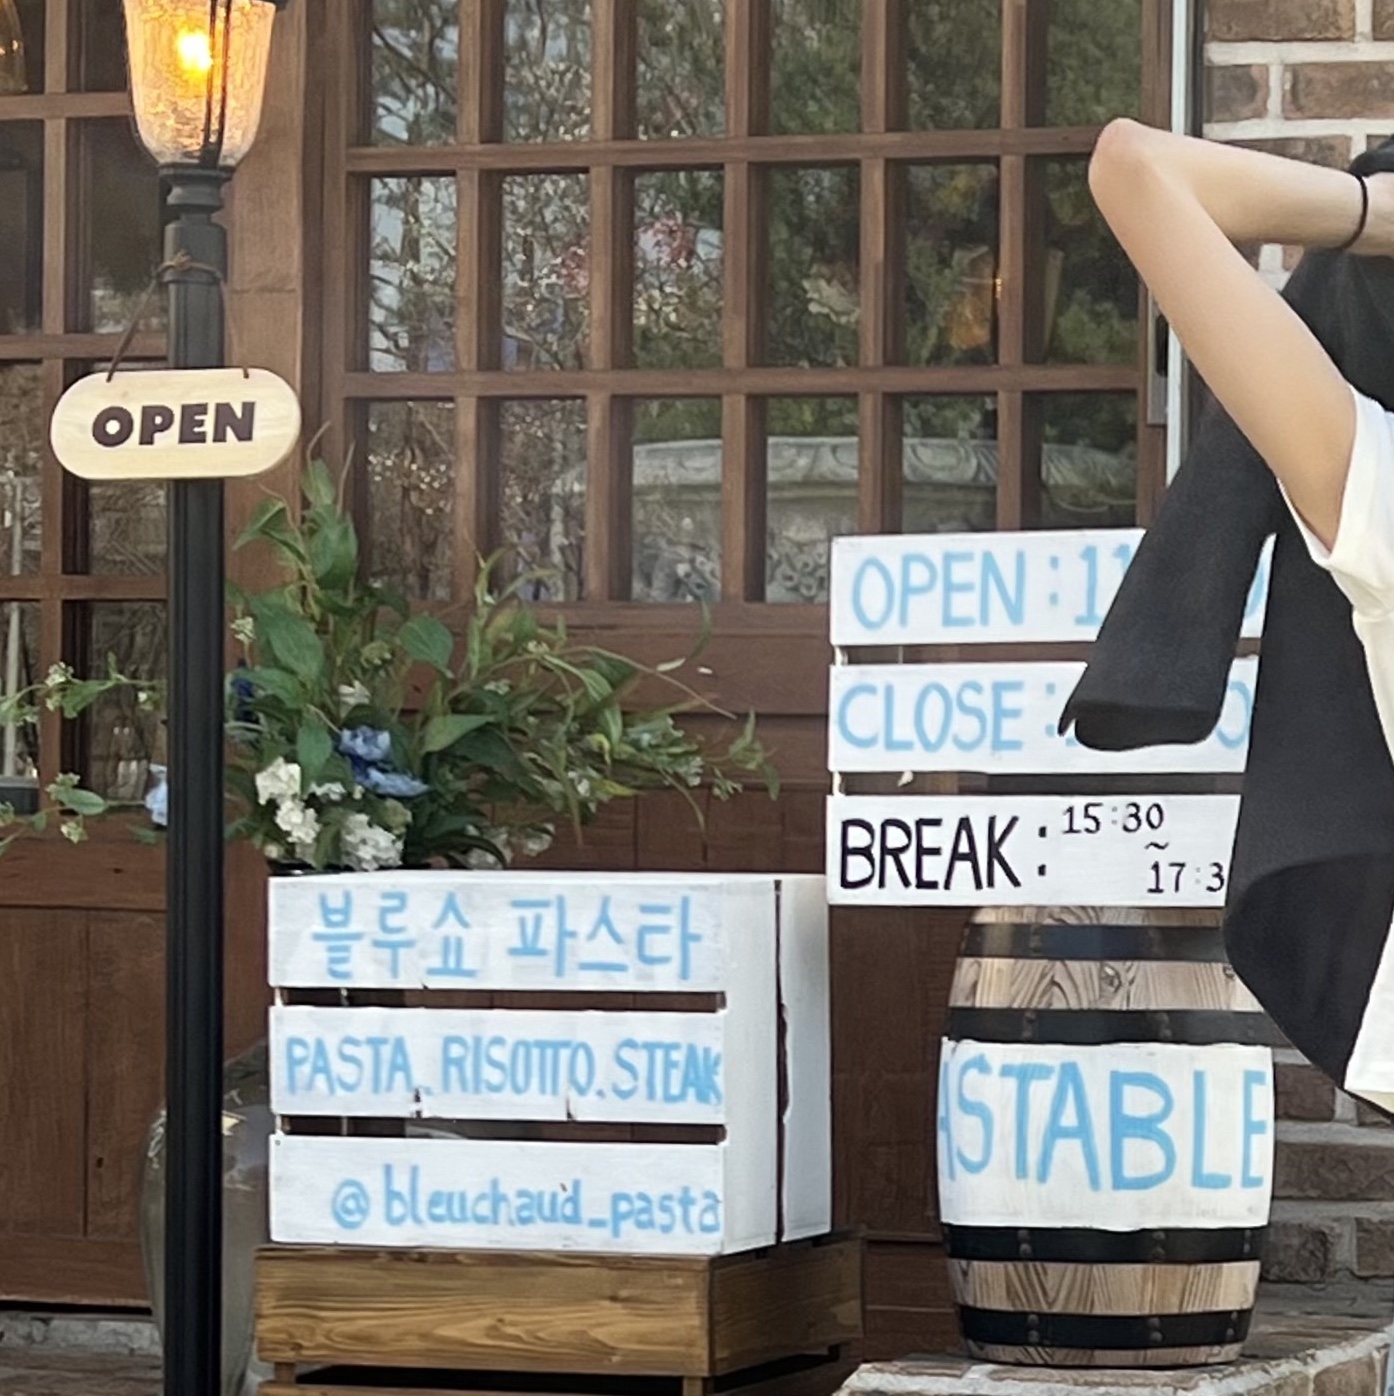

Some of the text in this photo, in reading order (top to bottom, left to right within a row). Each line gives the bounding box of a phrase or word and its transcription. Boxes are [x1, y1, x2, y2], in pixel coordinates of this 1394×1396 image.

[92, 401, 257, 448] OPEN
[1062, 802, 1165, 835] 15:30
[312, 890, 703, 981] 블루쇼 파스타
